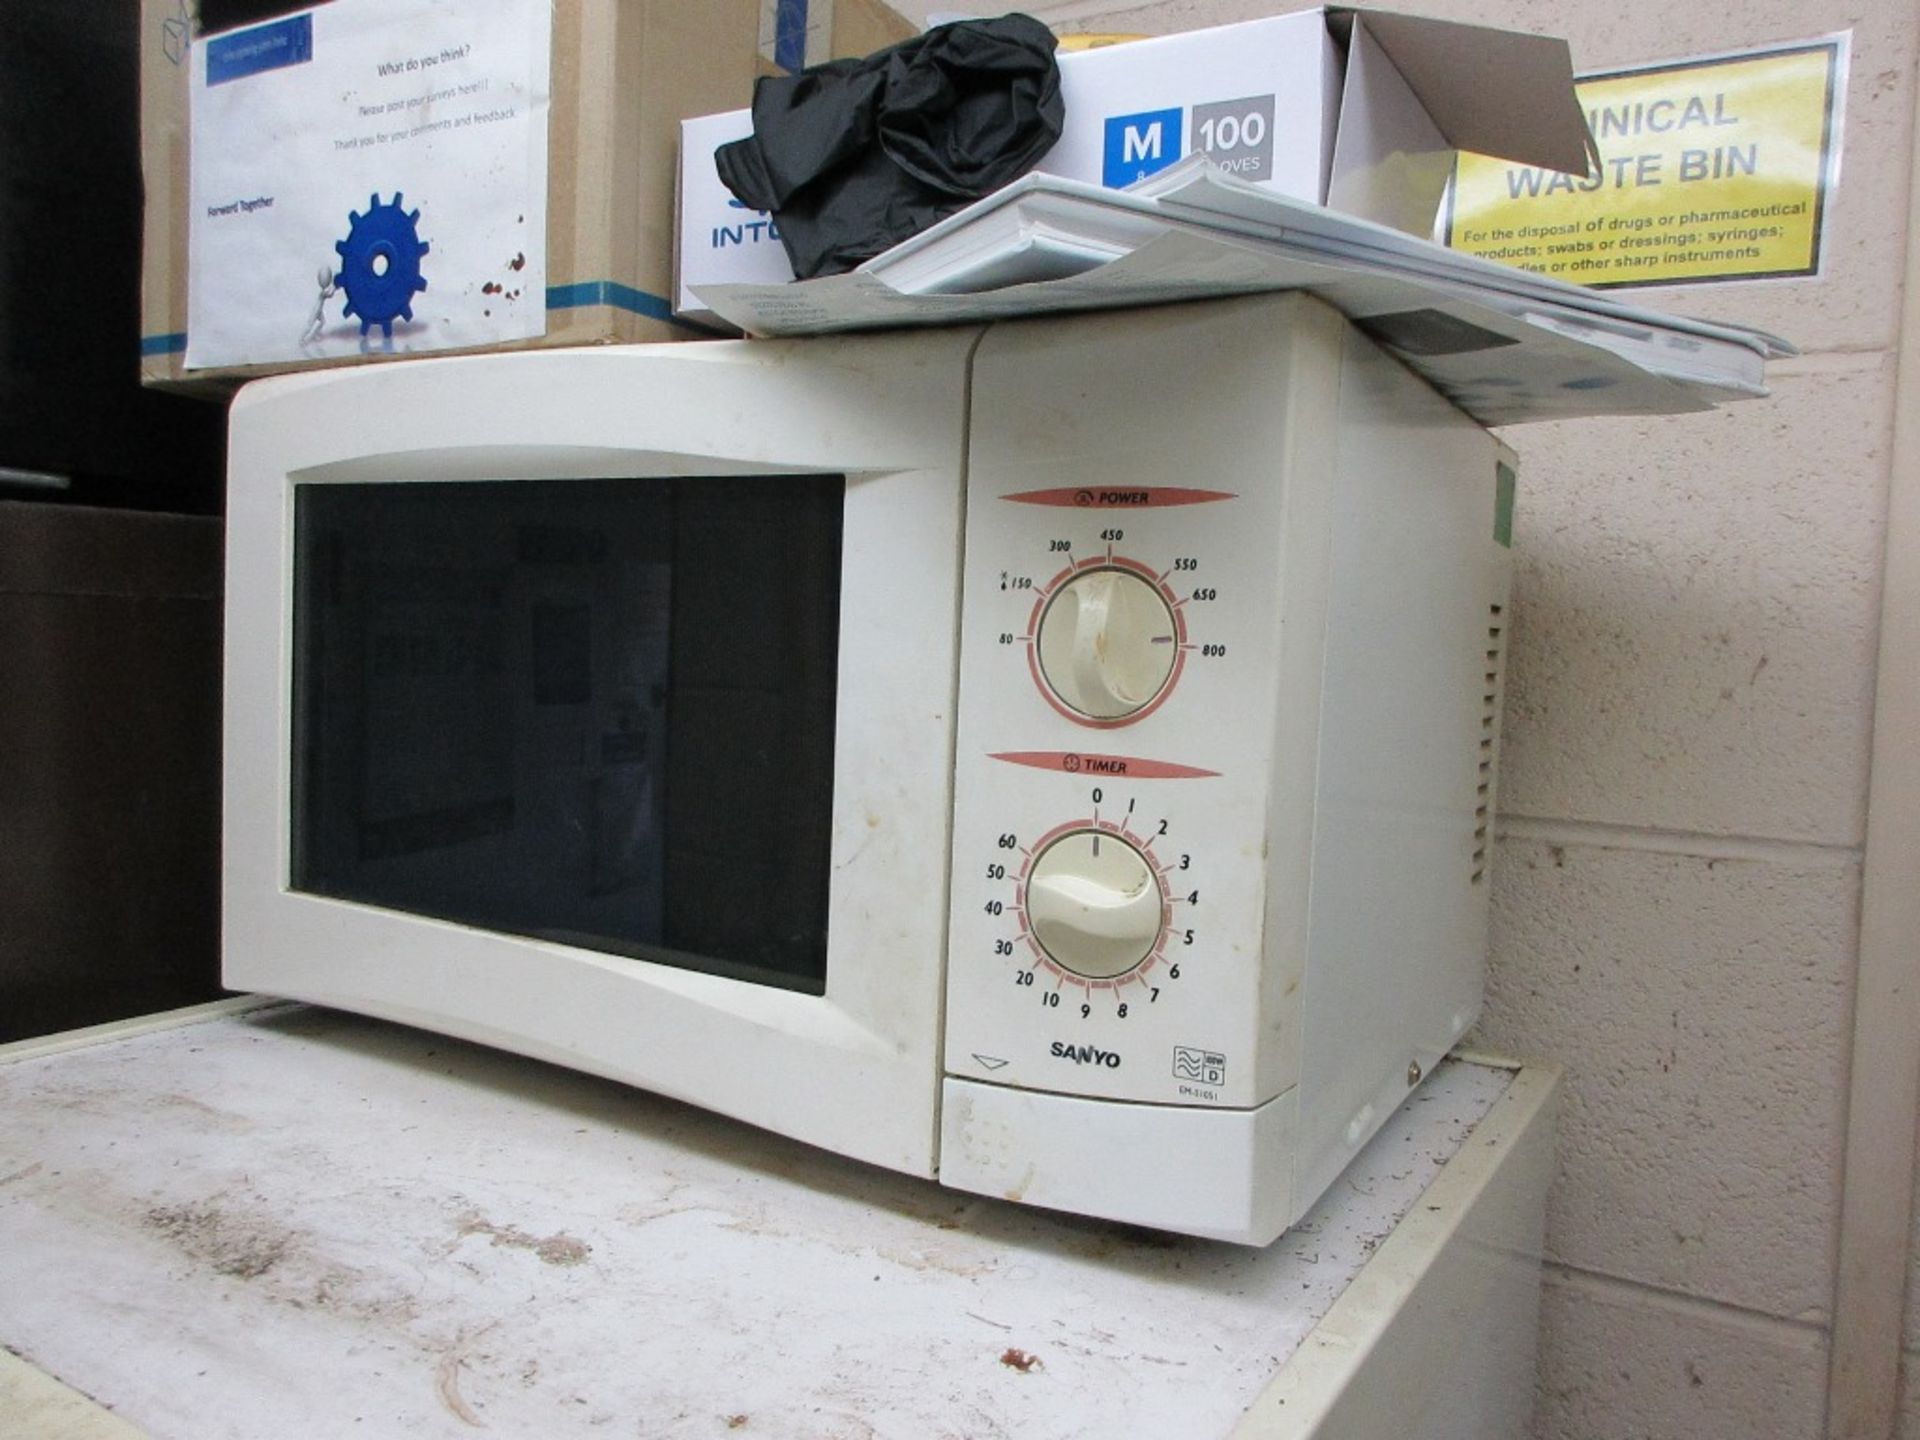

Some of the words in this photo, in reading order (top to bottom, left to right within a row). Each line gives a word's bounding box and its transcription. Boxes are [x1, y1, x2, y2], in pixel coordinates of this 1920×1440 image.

[376, 62, 404, 78] What
[406, 58, 418, 72] do
[420, 56, 438, 71] you
[440, 44, 471, 63] think?
[358, 104, 384, 117] Please
[406, 96, 428, 111] your
[1589, 93, 1738, 138] INICAL
[334, 136, 358, 150] Thank
[360, 136, 375, 149] you
[376, 132, 389, 144] for
[390, 129, 410, 144] your
[410, 118, 452, 137] comments
[453, 114, 471, 128] and
[473, 107, 515, 124] feedback
[1200, 112, 1265, 152] 100
[1123, 121, 1162, 163] M
[1219, 156, 1260, 174] OVES
[1679, 144, 1757, 182] BIN
[1463, 230, 1487, 243] For
[1492, 229, 1514, 241] the
[1518, 221, 1581, 239] disposal
[1586, 217, 1604, 232] of
[1608, 216, 1652, 231] drugs
[1658, 214, 1675, 226] or
[1679, 201, 1807, 226] pharmaceutical
[1546, 241, 1594, 254] swabs
[1598, 239, 1616, 251] or
[1708, 225, 1783, 243] syringes;
[1551, 261, 1566, 273] or
[1570, 257, 1611, 271] other
[1615, 253, 1658, 268] sharp
[1663, 246, 1761, 265] instruments
[1099, 491, 1149, 505] POWER
[1100, 530, 1123, 541] 450
[1049, 540, 1071, 552] 300
[1174, 558, 1197, 571] 550
[1011, 577, 1032, 589] 150
[1192, 589, 1216, 601] 650
[999, 633, 1014, 645] 80
[1202, 645, 1226, 657] 800
[1085, 760, 1128, 774] TIMER
[1092, 788, 1103, 803] 0
[1128, 798, 1135, 813] 1
[1158, 820, 1168, 835] 2
[998, 834, 1017, 849] 60
[1179, 855, 1190, 870] 3
[986, 865, 1004, 880] 50
[1187, 890, 1199, 906] 4
[984, 901, 1002, 916] 40
[1184, 930, 1195, 945] 5
[994, 940, 1013, 956] 30
[1015, 971, 1034, 986] 20
[1169, 964, 1181, 980] 6
[1042, 992, 1060, 1008] 10
[1150, 988, 1160, 1003] 7
[1081, 1005, 1091, 1019] 9
[1117, 1004, 1128, 1018] 8
[1050, 1041, 1121, 1069] SANYO
[1209, 1070, 1218, 1081] D
